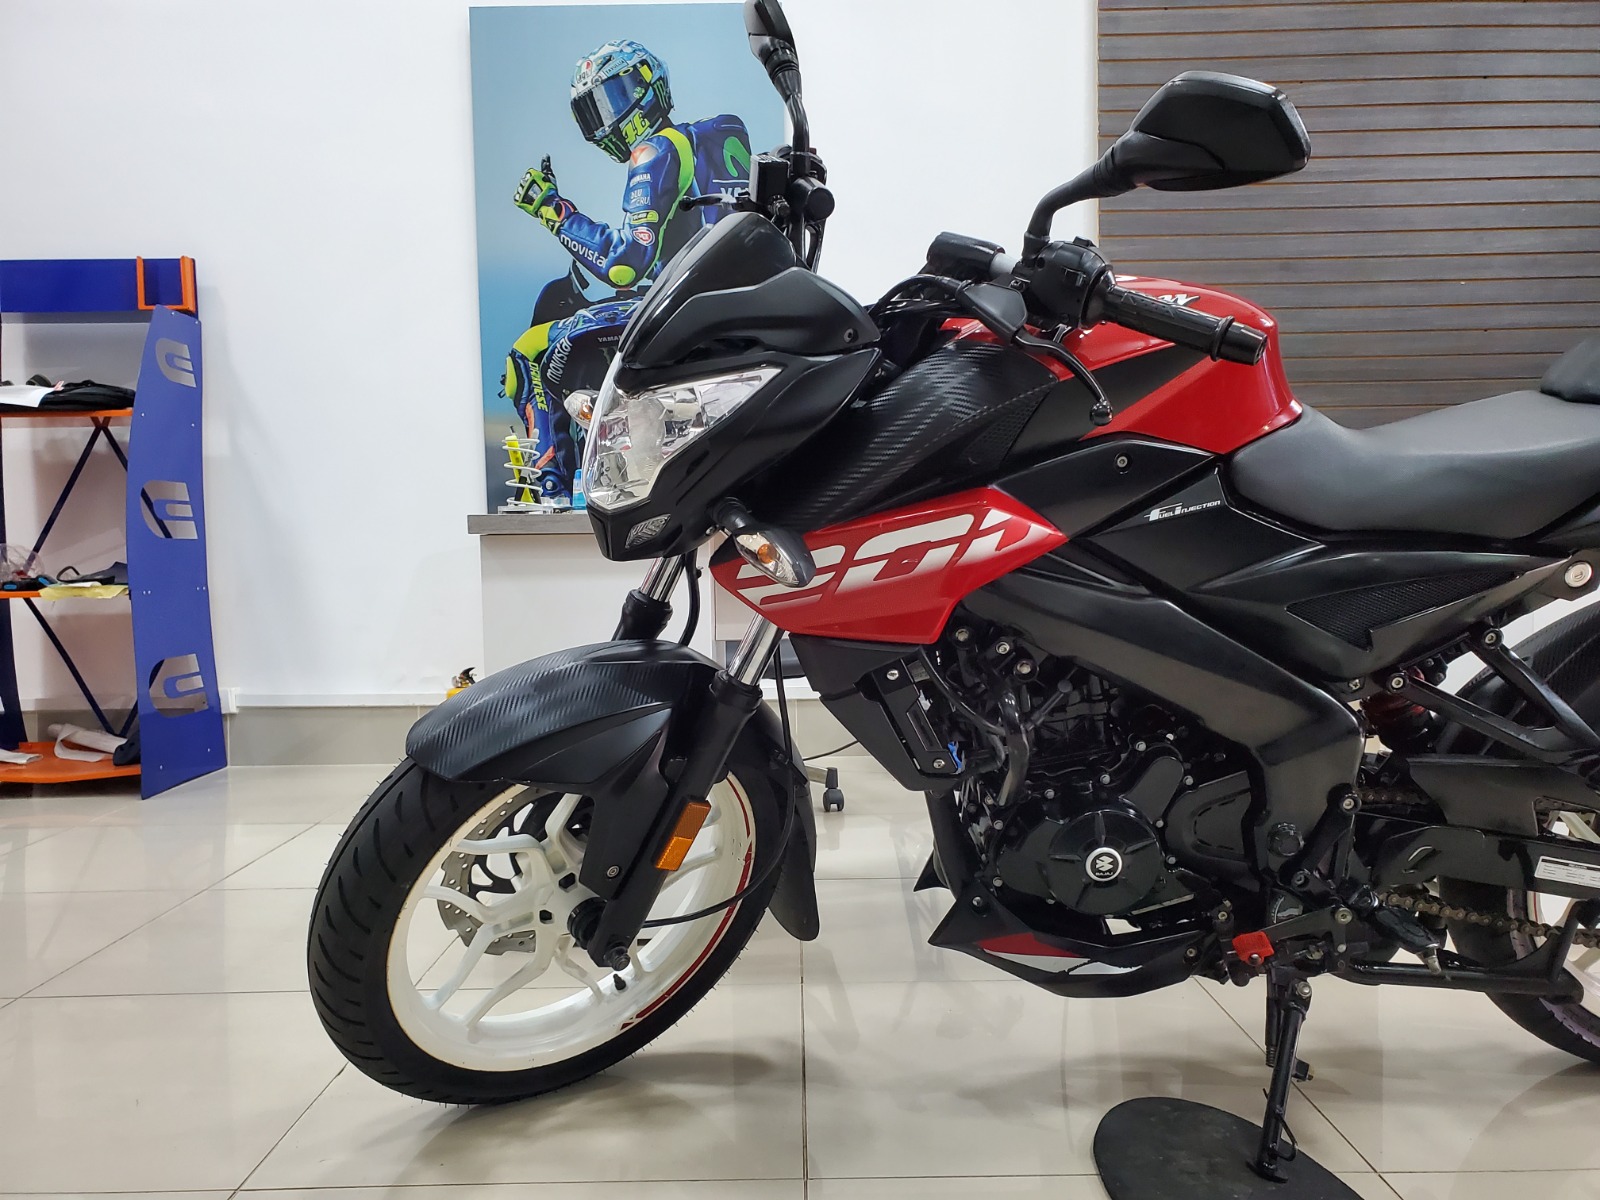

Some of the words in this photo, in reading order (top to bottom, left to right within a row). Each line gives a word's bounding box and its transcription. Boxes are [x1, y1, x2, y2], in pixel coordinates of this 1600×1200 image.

[622, 111, 650, 145] 46
[546, 336, 573, 384] movistar
[529, 361, 548, 412] DAINESE
